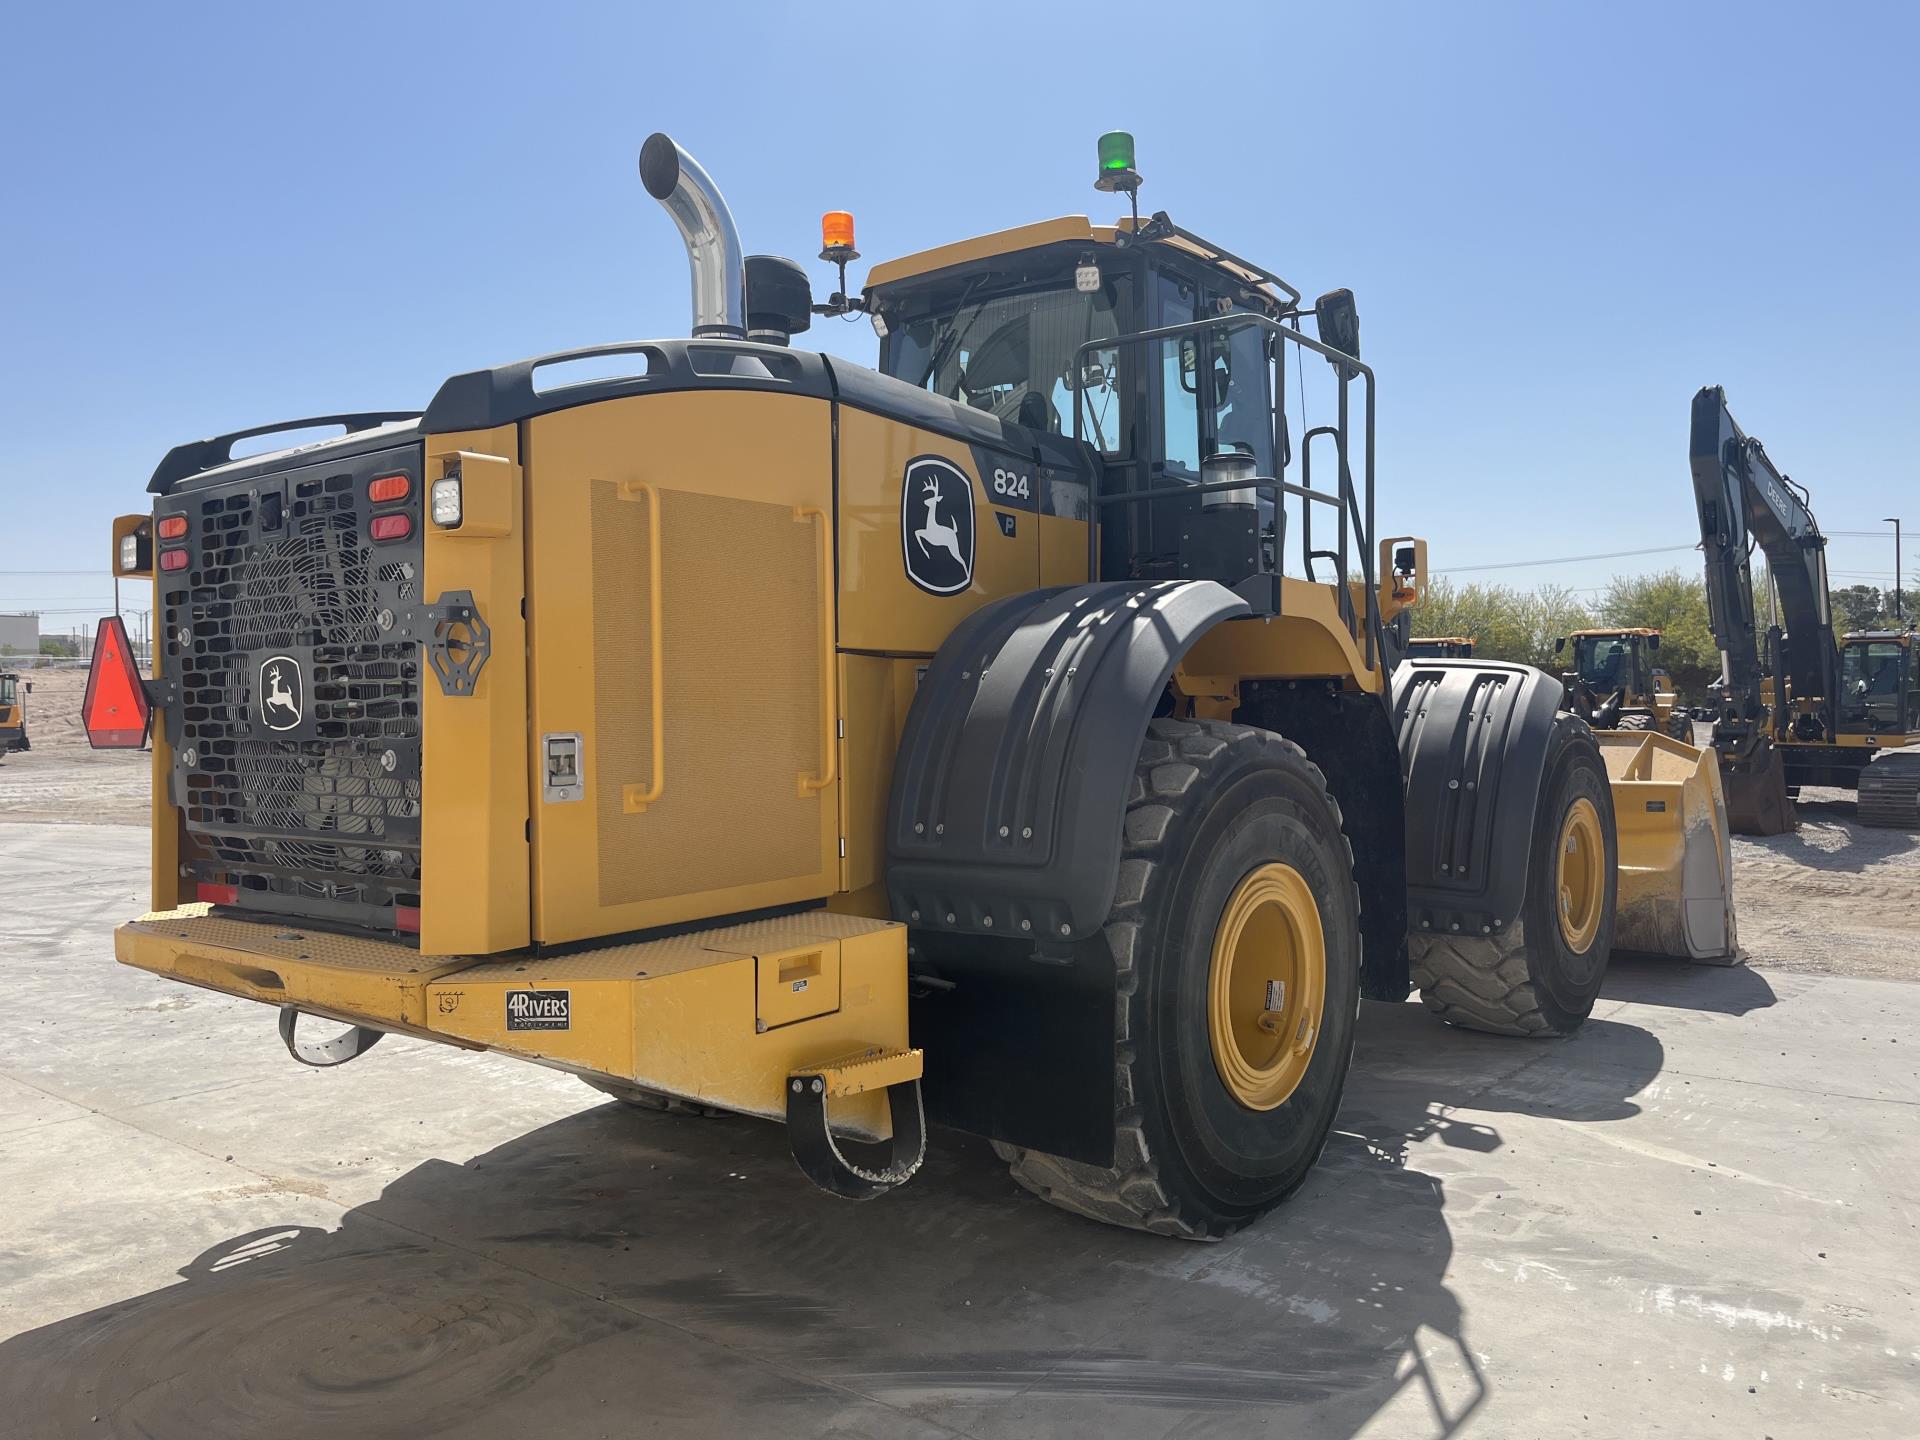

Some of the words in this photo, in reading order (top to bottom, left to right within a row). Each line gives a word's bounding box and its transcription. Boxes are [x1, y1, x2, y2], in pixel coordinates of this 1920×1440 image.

[994, 468, 1030, 500] 824
[1767, 481, 1787, 517] DEERE
[1005, 516, 1015, 534] P
[508, 993, 568, 1017] 4RIVERS
